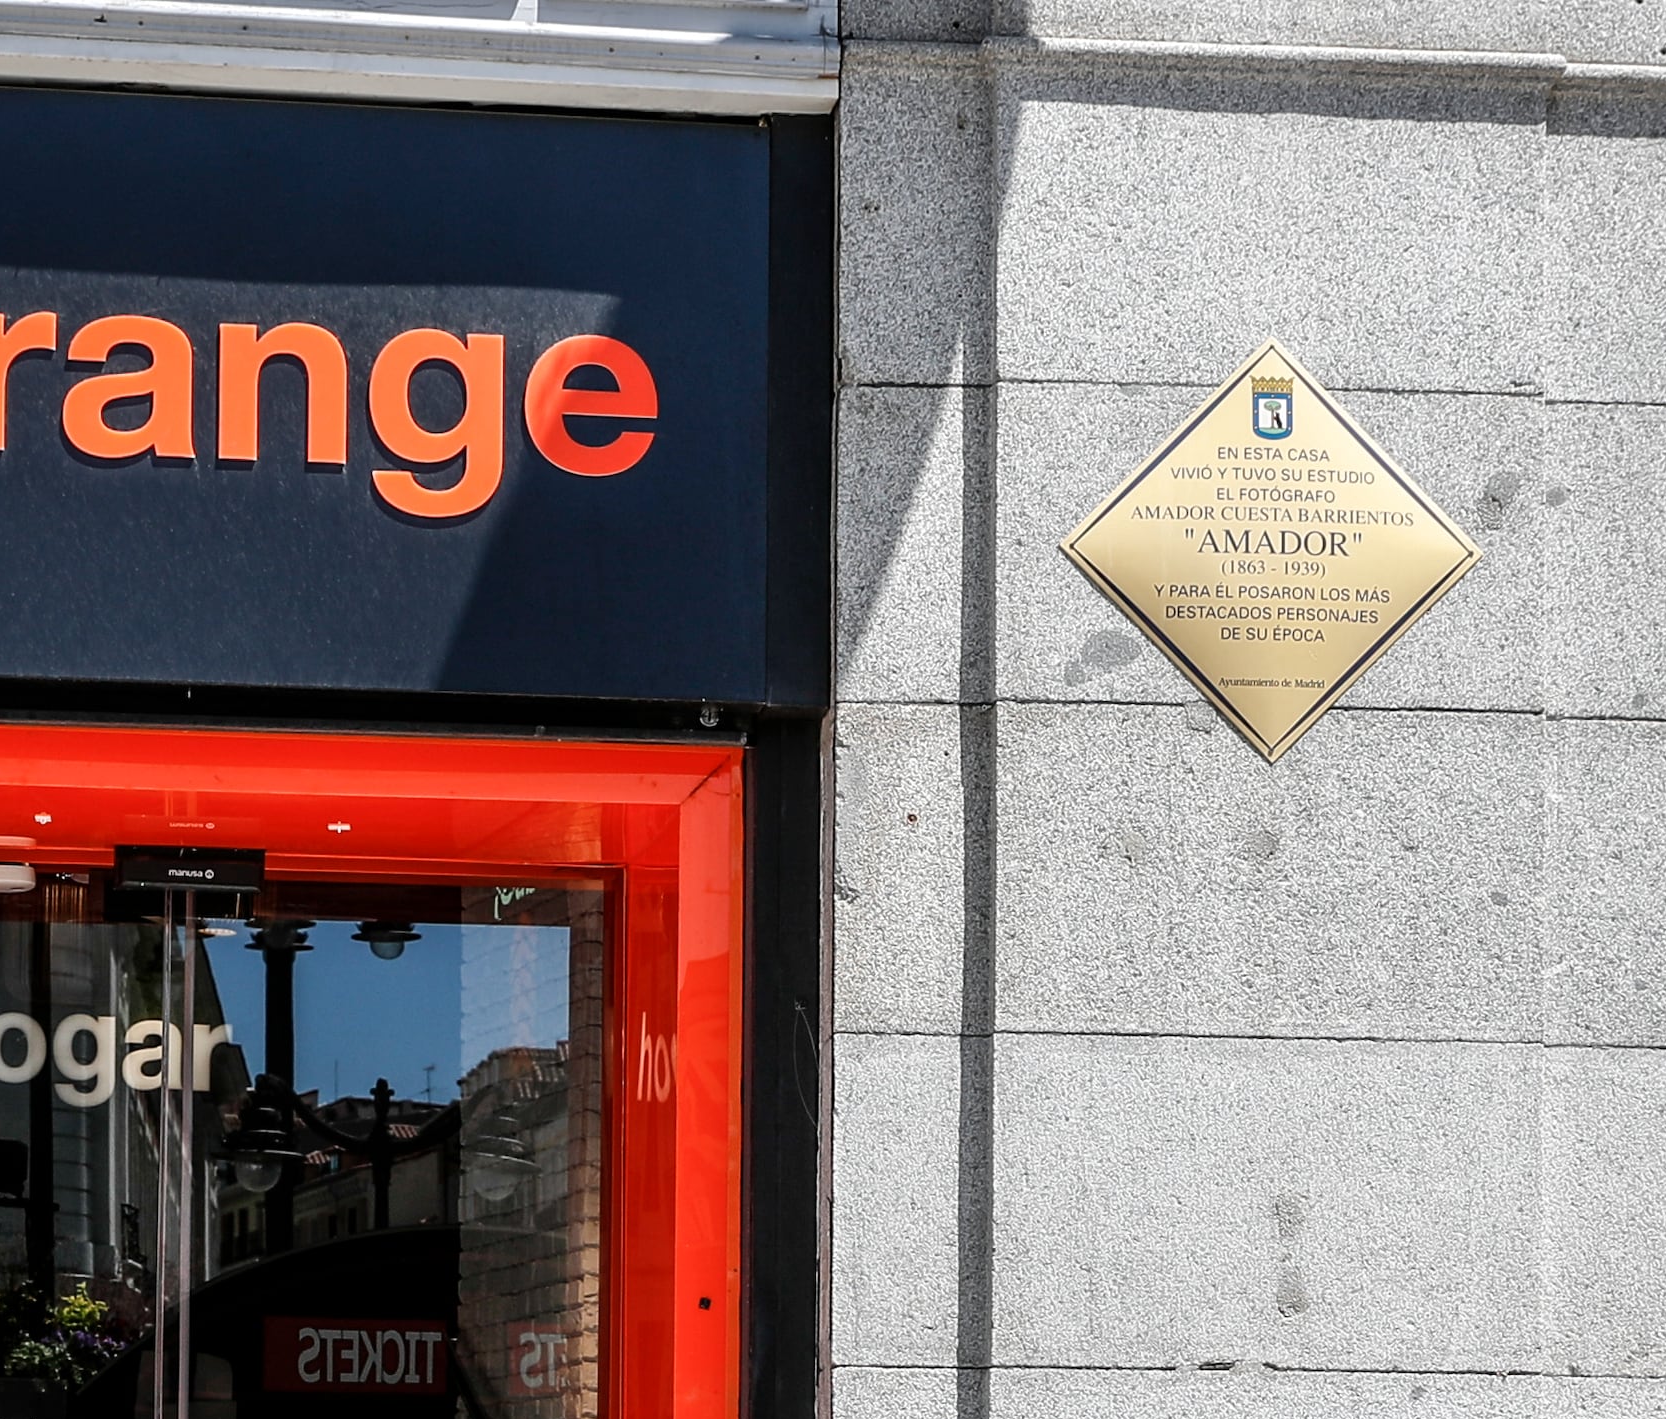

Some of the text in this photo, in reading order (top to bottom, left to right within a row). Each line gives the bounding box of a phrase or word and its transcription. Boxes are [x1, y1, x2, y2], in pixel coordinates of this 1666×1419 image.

[1217, 447, 1330, 462] EN ESTA CASA
[1171, 465, 1375, 484] VIVIÓ Y TUVO SU ESTUDIO
[1217, 485, 1335, 503] EL FOTÓGRAFO
[1131, 506, 1414, 526] AMADOR CUESTA BARRIENTOS
[1184, 528, 1362, 557] "AMADOR"
[1154, 582, 1390, 603] Y PARA ÉL POSARON LOS MÁS
[1166, 606, 1379, 623] DESTACADOS PERSONAJES
[1220, 625, 1325, 642] DE SU ÉPOCA
[1219, 678, 1324, 689] Ayuntamiento de Madrid
[168, 869, 203, 877] manusa
